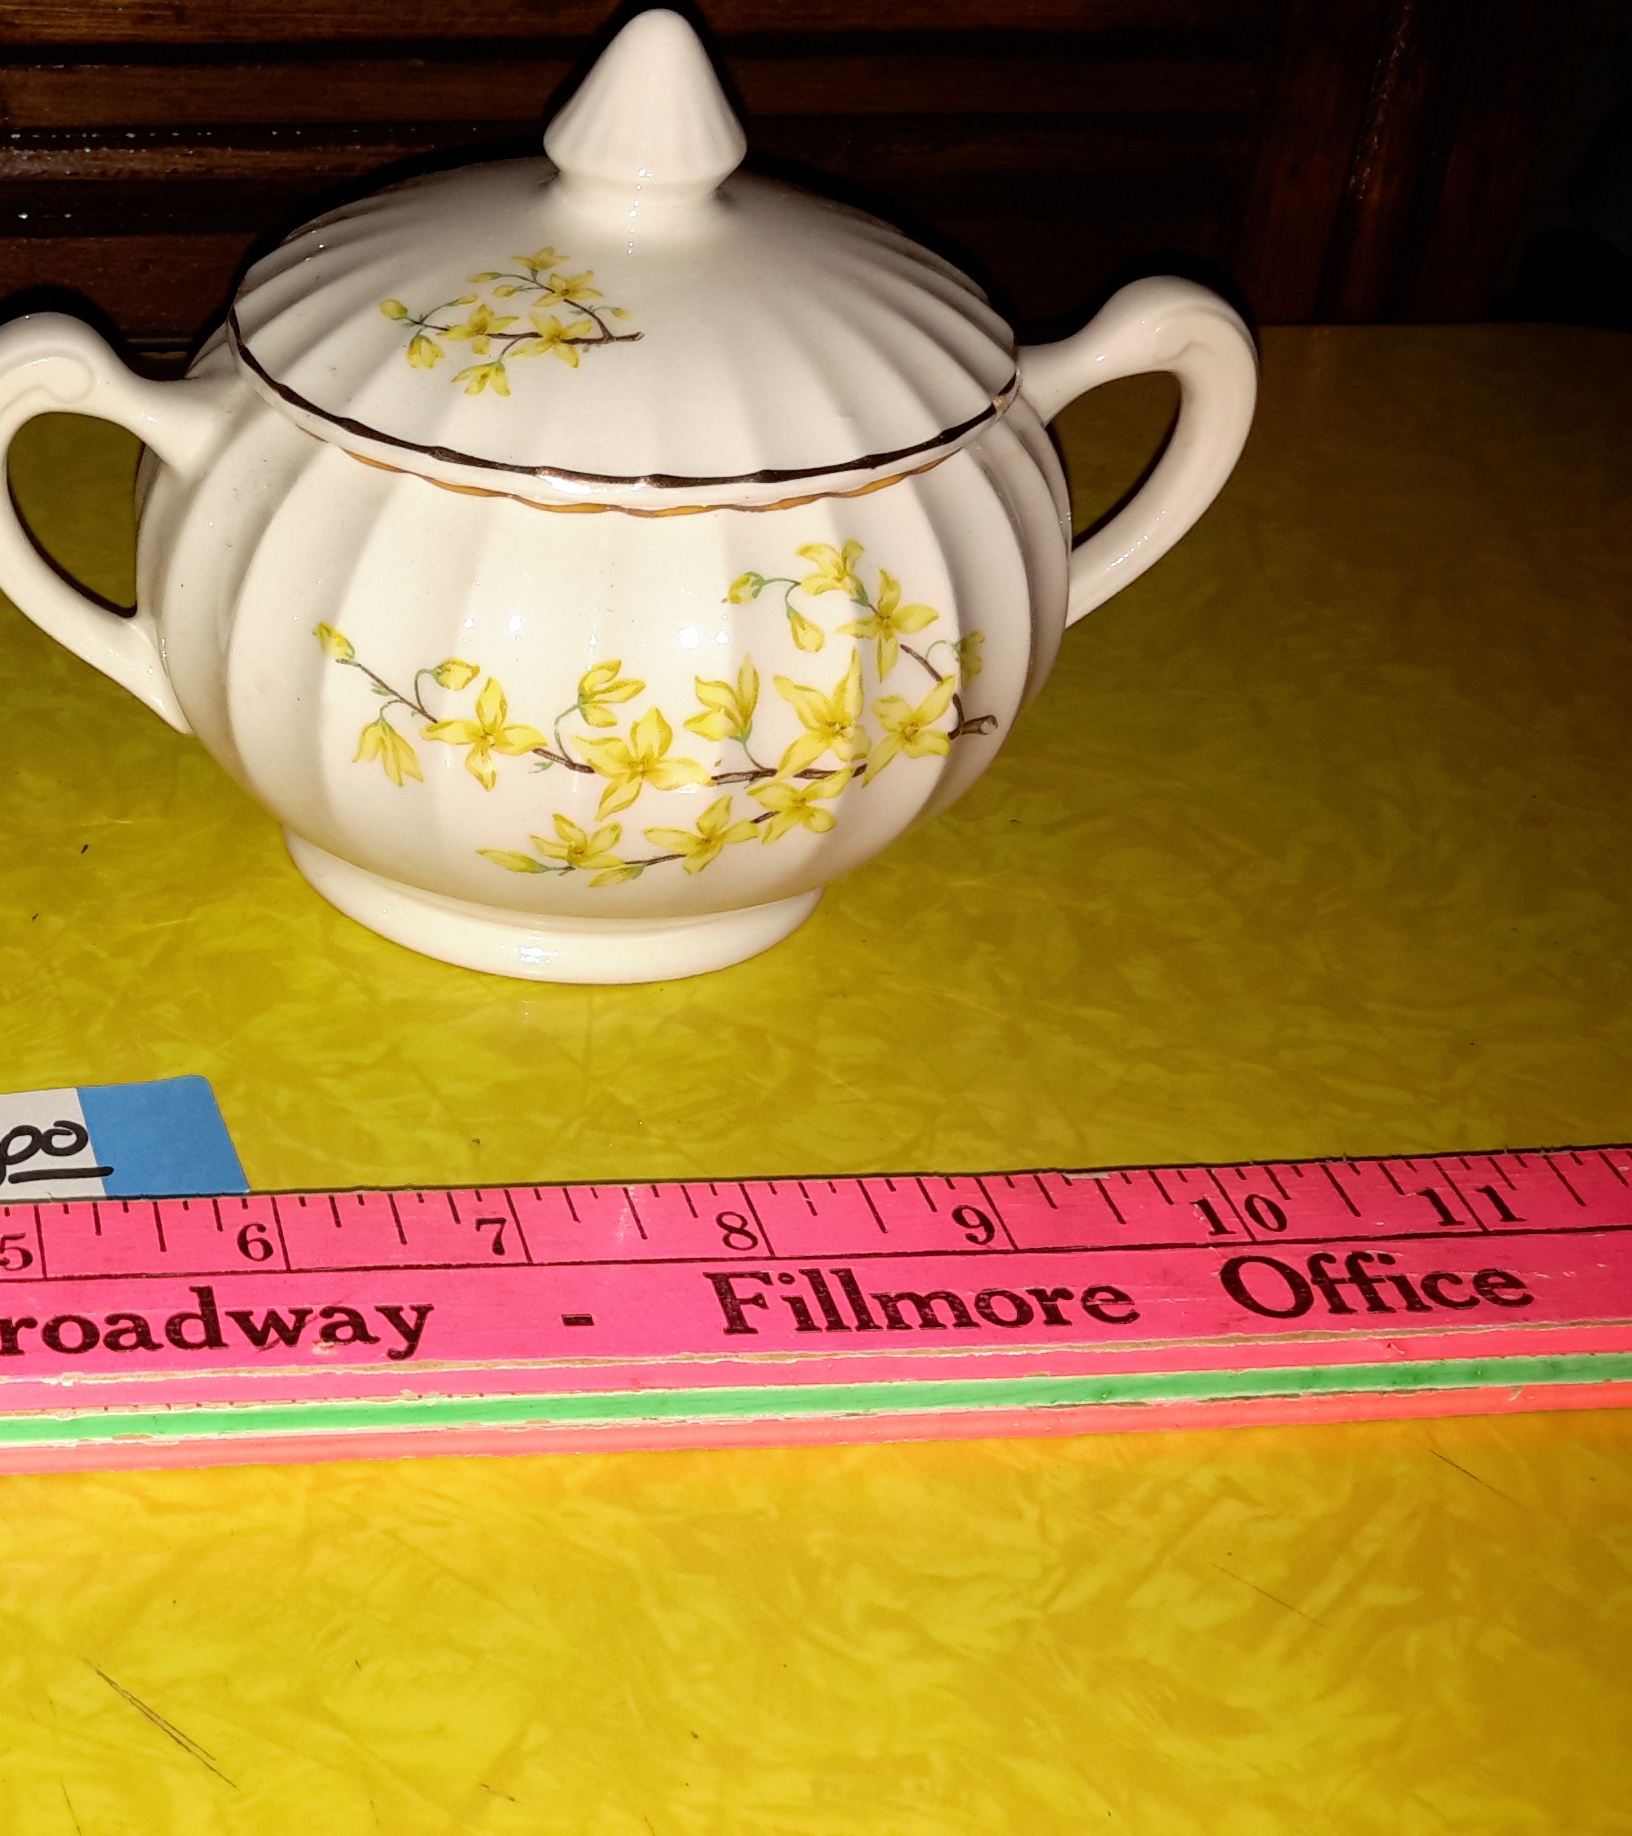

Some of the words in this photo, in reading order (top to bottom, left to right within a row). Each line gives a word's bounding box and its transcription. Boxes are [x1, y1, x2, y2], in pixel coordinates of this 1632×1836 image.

[237, 1222, 274, 1263] 6
[475, 1217, 508, 1256] 7
[715, 1210, 760, 1251] 8
[951, 1204, 996, 1246] 9
[1190, 1193, 1289, 1237] 10
[703, 1267, 1141, 1337] Fillmore
[1218, 1250, 1536, 1320] Office
